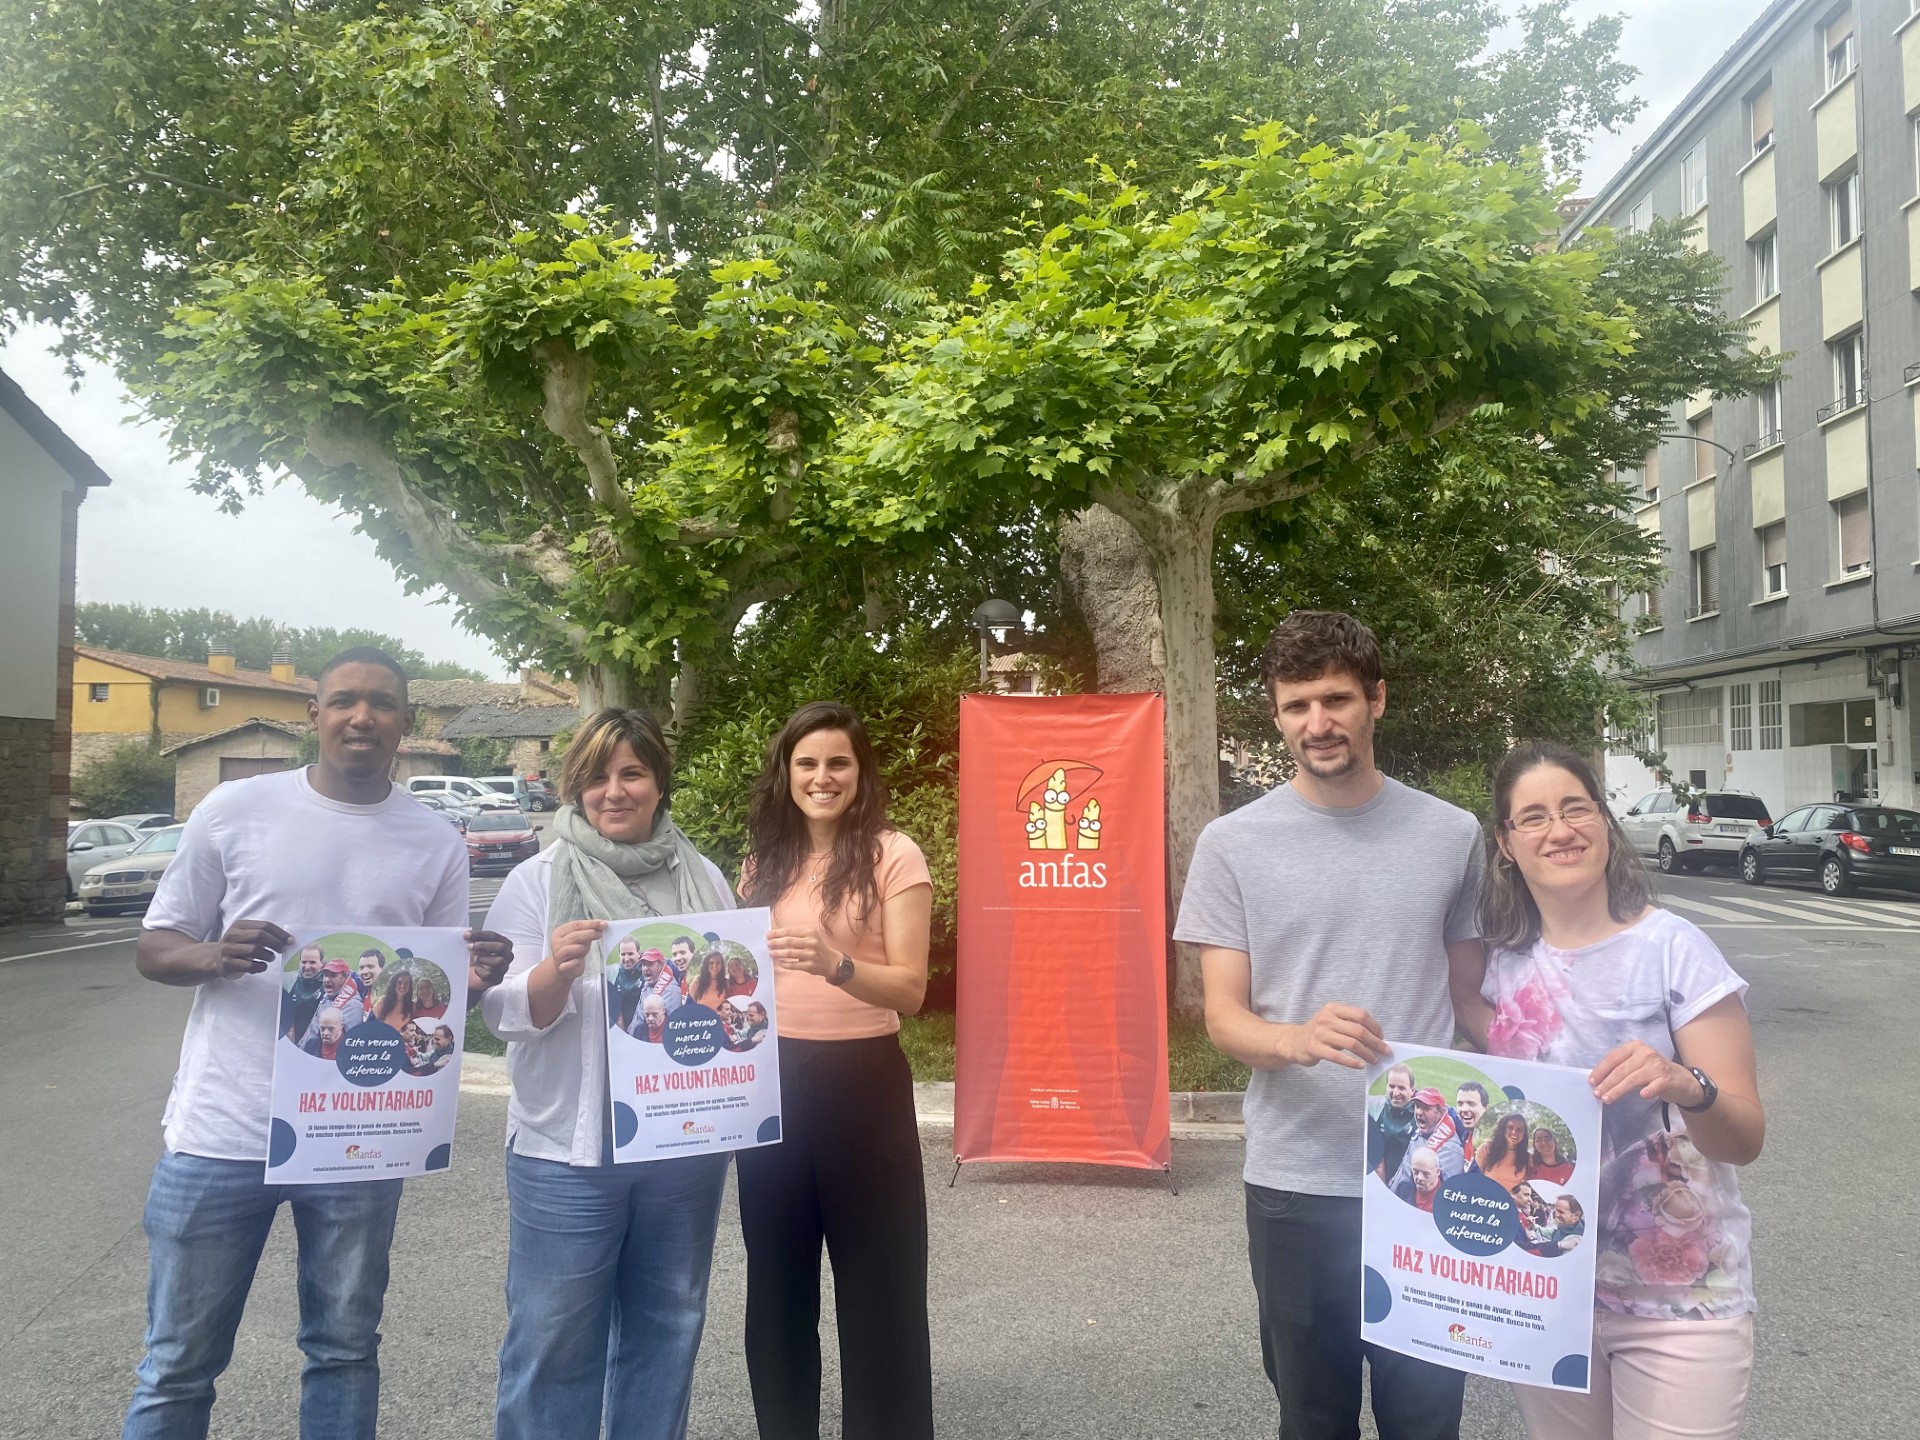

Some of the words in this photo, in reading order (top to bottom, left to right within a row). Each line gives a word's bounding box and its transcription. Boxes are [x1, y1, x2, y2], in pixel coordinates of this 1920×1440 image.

[1019, 853, 1107, 888] anfas
[668, 1020, 686, 1030] Este
[689, 1019, 717, 1028] verano
[345, 1038, 365, 1047] Este
[676, 1034, 700, 1042] marca
[350, 1053, 378, 1061] marca
[380, 1050, 391, 1060] la
[673, 1044, 715, 1058] diferencia
[346, 1064, 393, 1077] diferencia
[636, 1074, 660, 1095] HAZ
[663, 1064, 755, 1091] VOLUNTARIADO
[299, 1092, 327, 1112] HAZ
[332, 1089, 433, 1111] VOLUNTARIADO
[360, 1150, 382, 1160] anfas
[1444, 1189, 1467, 1202] Este
[1471, 1196, 1510, 1210] verano
[1450, 1210, 1484, 1224] marca
[1486, 1214, 1500, 1227] la
[1446, 1226, 1504, 1245] diferencia
[1392, 1244, 1424, 1274] HAZ
[1429, 1254, 1558, 1300] VOLUNTARIADO
[1402, 1294, 1411, 1302] hay
[1412, 1297, 1433, 1307] muchas
[1434, 1302, 1460, 1314] opciones
[1469, 1310, 1505, 1324] voluntariado.
[1428, 1291, 1446, 1301] tiempo
[1466, 1301, 1482, 1309] ganas
[1492, 1306, 1514, 1316] ayudar,
[1465, 1336, 1492, 1349] anfas
